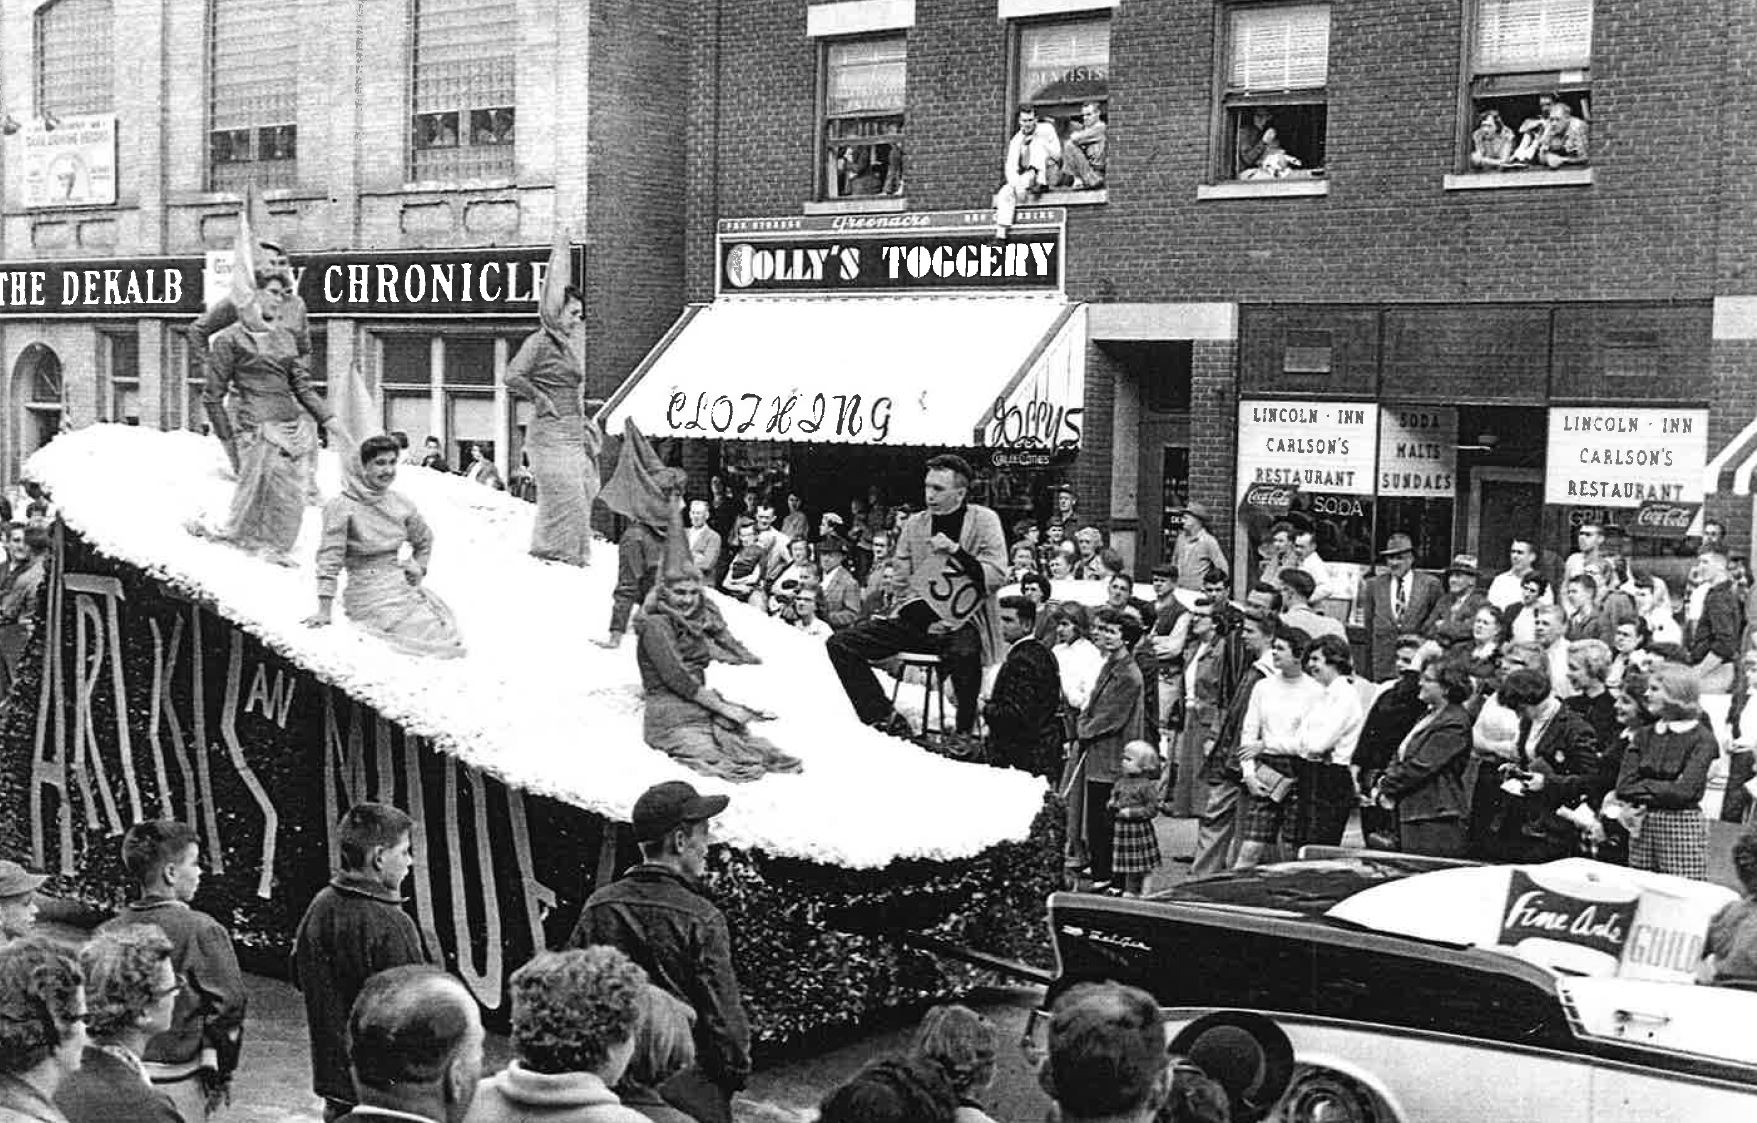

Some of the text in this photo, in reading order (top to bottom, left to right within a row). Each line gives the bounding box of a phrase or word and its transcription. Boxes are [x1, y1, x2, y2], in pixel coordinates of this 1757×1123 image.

[882, 242, 1055, 279] TOGGERY
[61, 267, 183, 306] DEKALB
[1253, 407, 1364, 425] LINCOLN INN
[1400, 412, 1439, 429] SODA
[1563, 415, 1693, 434] LINCOLN INN
[1266, 437, 1350, 455] CARLSON'S
[1580, 447, 1673, 467] CARLSON'S
[1255, 467, 1356, 487] RESTAURANT
[1568, 479, 1685, 502] RESTAURANT
[1313, 496, 1364, 517] SODA
[929, 556, 979, 619] 30
[1505, 890, 1624, 944] Fine Arts
[1629, 923, 1703, 974] GUILD
